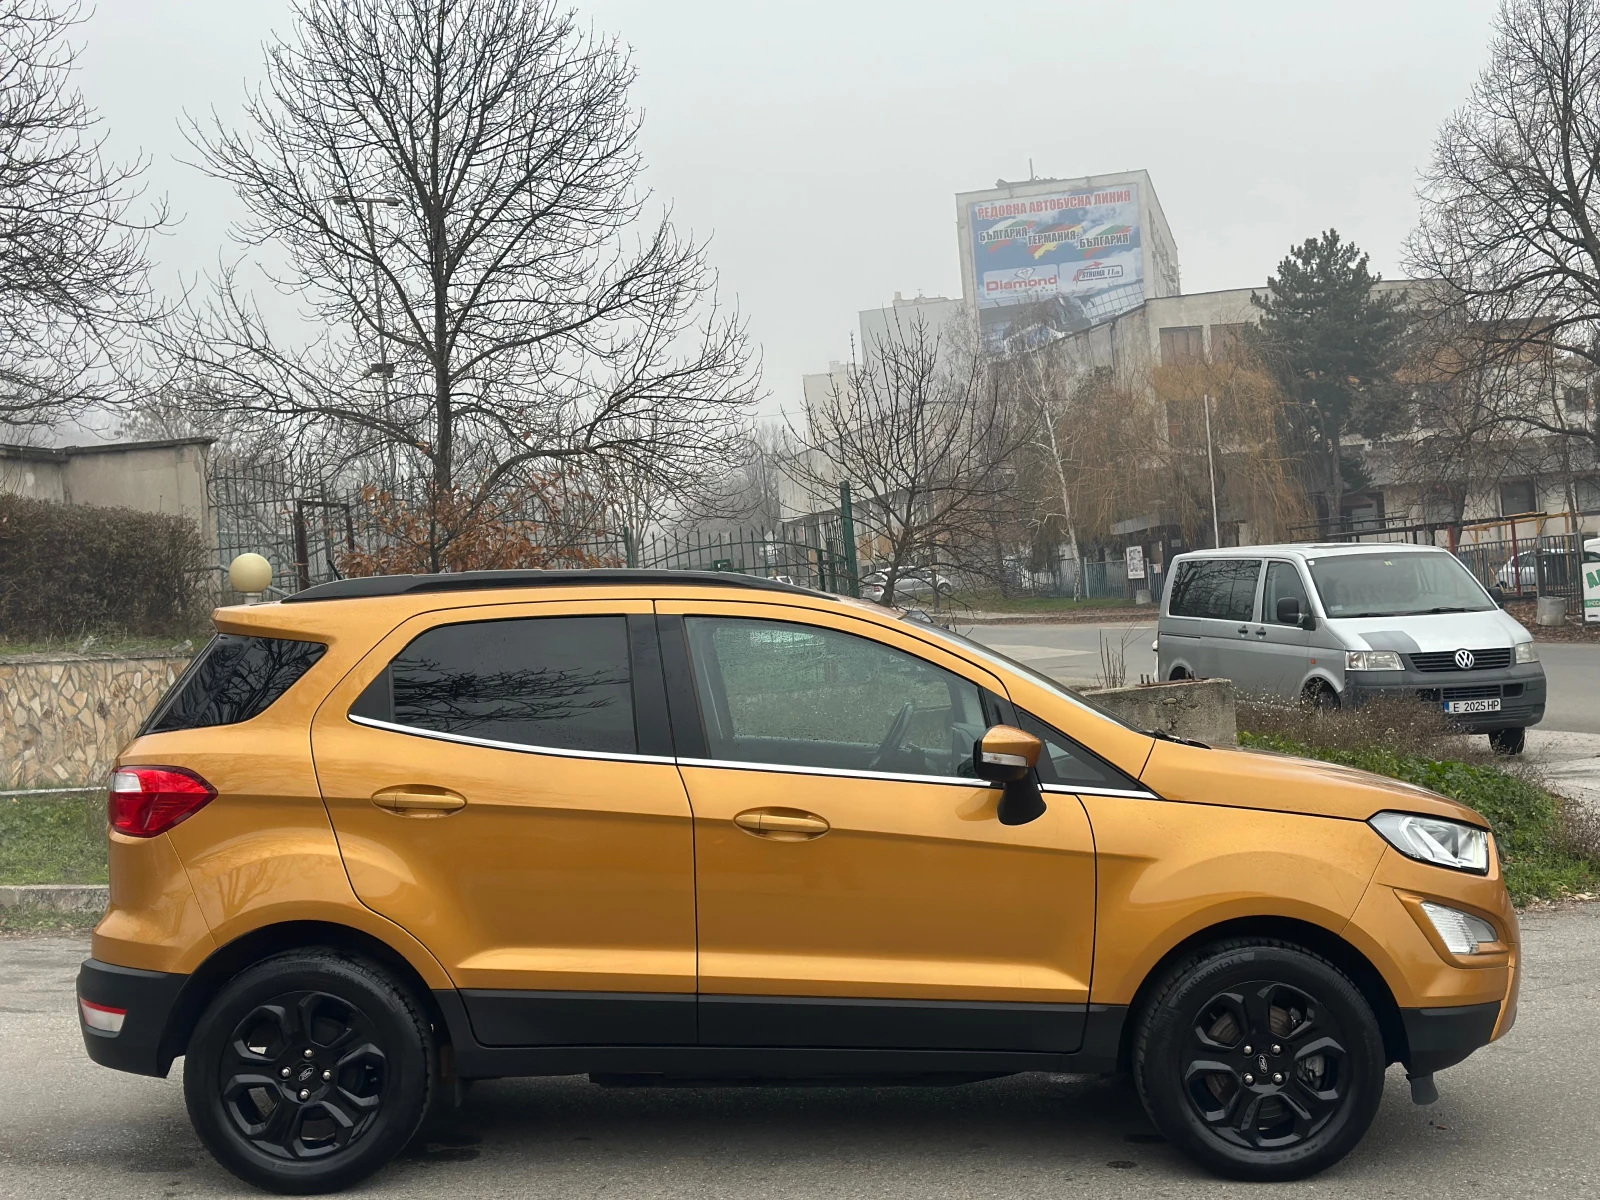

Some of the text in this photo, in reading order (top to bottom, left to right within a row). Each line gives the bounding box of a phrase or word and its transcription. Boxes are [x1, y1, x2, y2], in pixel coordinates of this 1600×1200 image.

[978, 190, 1130, 219] РЕДОВНА АВТОБУСНА ЛИНИЯ
[1080, 234, 1129, 248] БЪЛГАРИЯ
[986, 274, 1057, 291] Diamond
[1453, 700, 1500, 713] E 2025 HP
